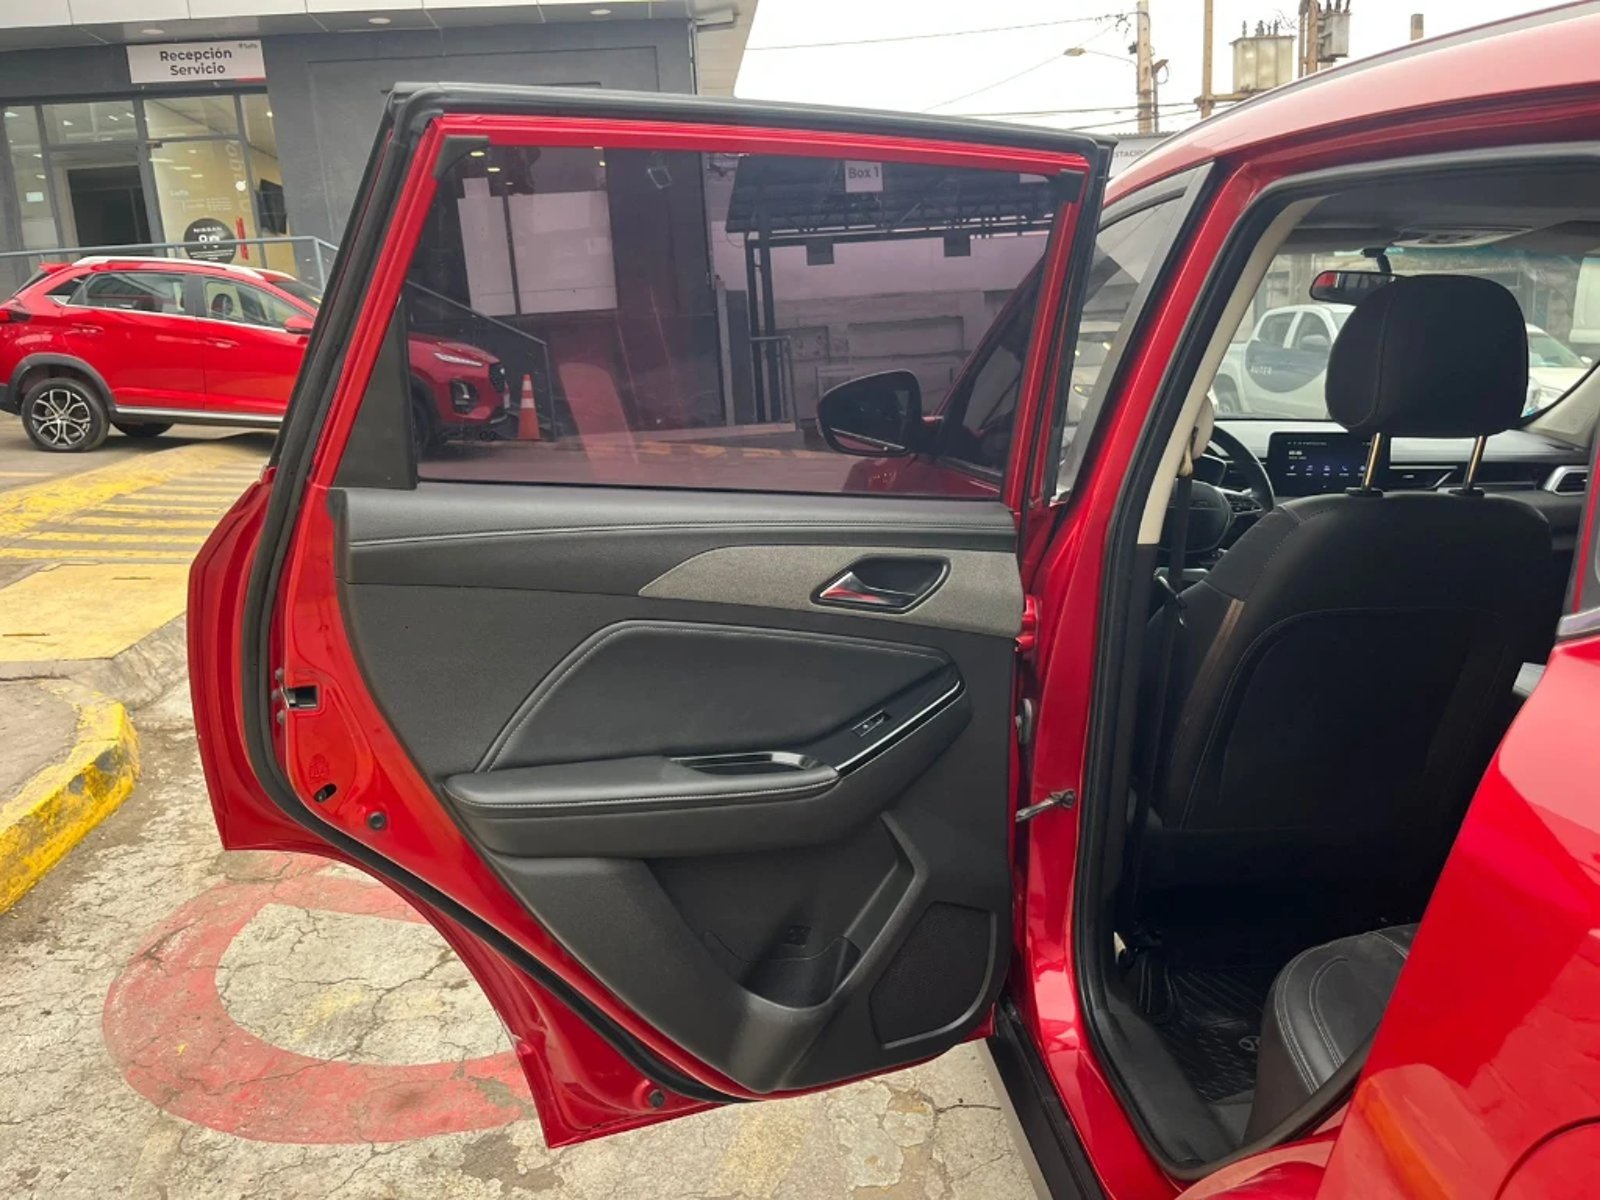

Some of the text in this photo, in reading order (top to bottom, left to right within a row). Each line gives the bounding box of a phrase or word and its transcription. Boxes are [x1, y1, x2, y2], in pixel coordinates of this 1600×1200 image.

[160, 47, 232, 63] Recepción
[170, 62, 226, 76] Servicio
[848, 166, 879, 179] Box 1
